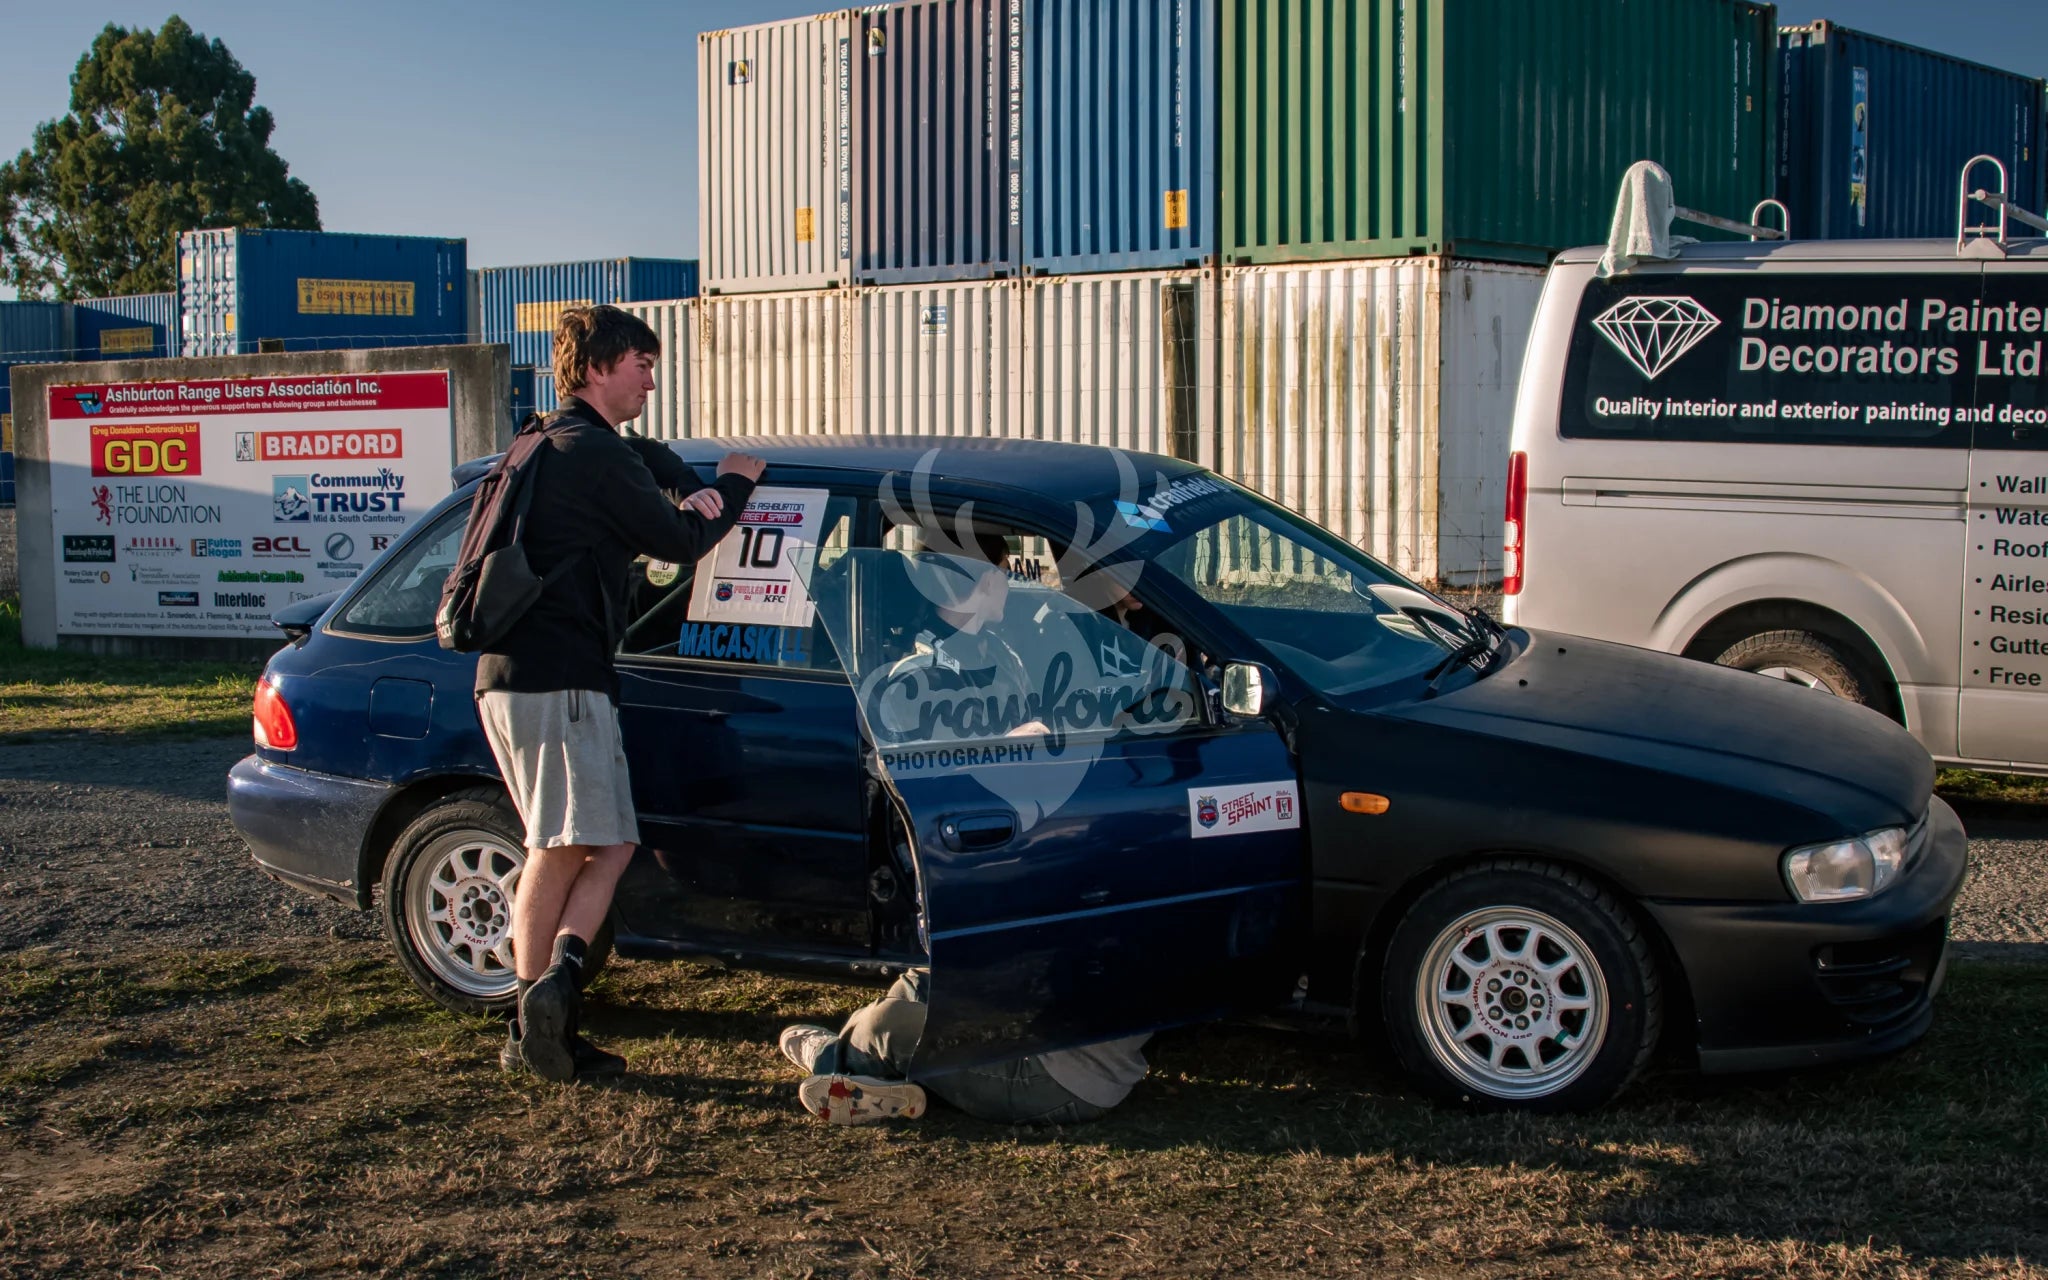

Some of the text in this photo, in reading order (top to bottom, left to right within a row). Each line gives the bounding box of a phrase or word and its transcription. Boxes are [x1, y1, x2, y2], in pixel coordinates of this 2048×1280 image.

[1010, 17, 1020, 33] CAN
[840, 43, 848, 59] YOU
[1010, 36, 1020, 48] DO
[840, 60, 848, 76] CAN
[1010, 50, 1020, 90] ANYTHING
[840, 77, 848, 88] DO
[1010, 92, 1020, 102] IN
[840, 129, 848, 138] IN
[1010, 113, 1020, 137] ROYAL
[840, 146, 848, 170] ROYAL
[1010, 139, 1020, 161] WOLF
[840, 171, 848, 192] WOLF
[1010, 173, 1020, 226] 0800 266 824
[1743, 298, 1907, 332] Diamond
[1739, 337, 2042, 377] Decorators Ltd
[105, 378, 382, 402] Ashburton Range Users Association Inc.
[109, 399, 377, 414] Gratefully acknowledges the generous support from the following groups and businesses
[1594, 397, 1662, 420] Quality
[1665, 398, 1738, 417] interior
[1741, 400, 1777, 418] and
[1781, 401, 1859, 420] exterior
[1865, 402, 1950, 426] painting
[1955, 404, 1995, 423] and
[92, 424, 197, 436] Greg Donaldson Contracting Ltd
[266, 433, 397, 457] BRADFORD
[104, 439, 187, 474] GDC
[116, 485, 186, 503] THE LION
[1996, 475, 2047, 494] Wall
[311, 492, 405, 512] TRUST
[757, 502, 805, 511] ASHBURTON
[118, 504, 221, 524] FOUNDATION
[313, 514, 406, 524] Mid & South Canterbury
[740, 512, 797, 522] TREET SPRINT
[208, 538, 242, 548] Fulton
[208, 548, 242, 558] Hogan
[739, 526, 785, 568] 10
[1990, 573, 2048, 593] Airle
[214, 591, 265, 607] Interbloc
[763, 594, 786, 603] KFC
[678, 621, 807, 662] MACASKILL
[1989, 667, 2042, 686] Free
[1221, 792, 1255, 815] STREET
[1228, 796, 1272, 826] SPRINT
[447, 897, 462, 930] SPRINT
[464, 934, 489, 945] HART
[1471, 971, 1508, 1039] COMPETITION
